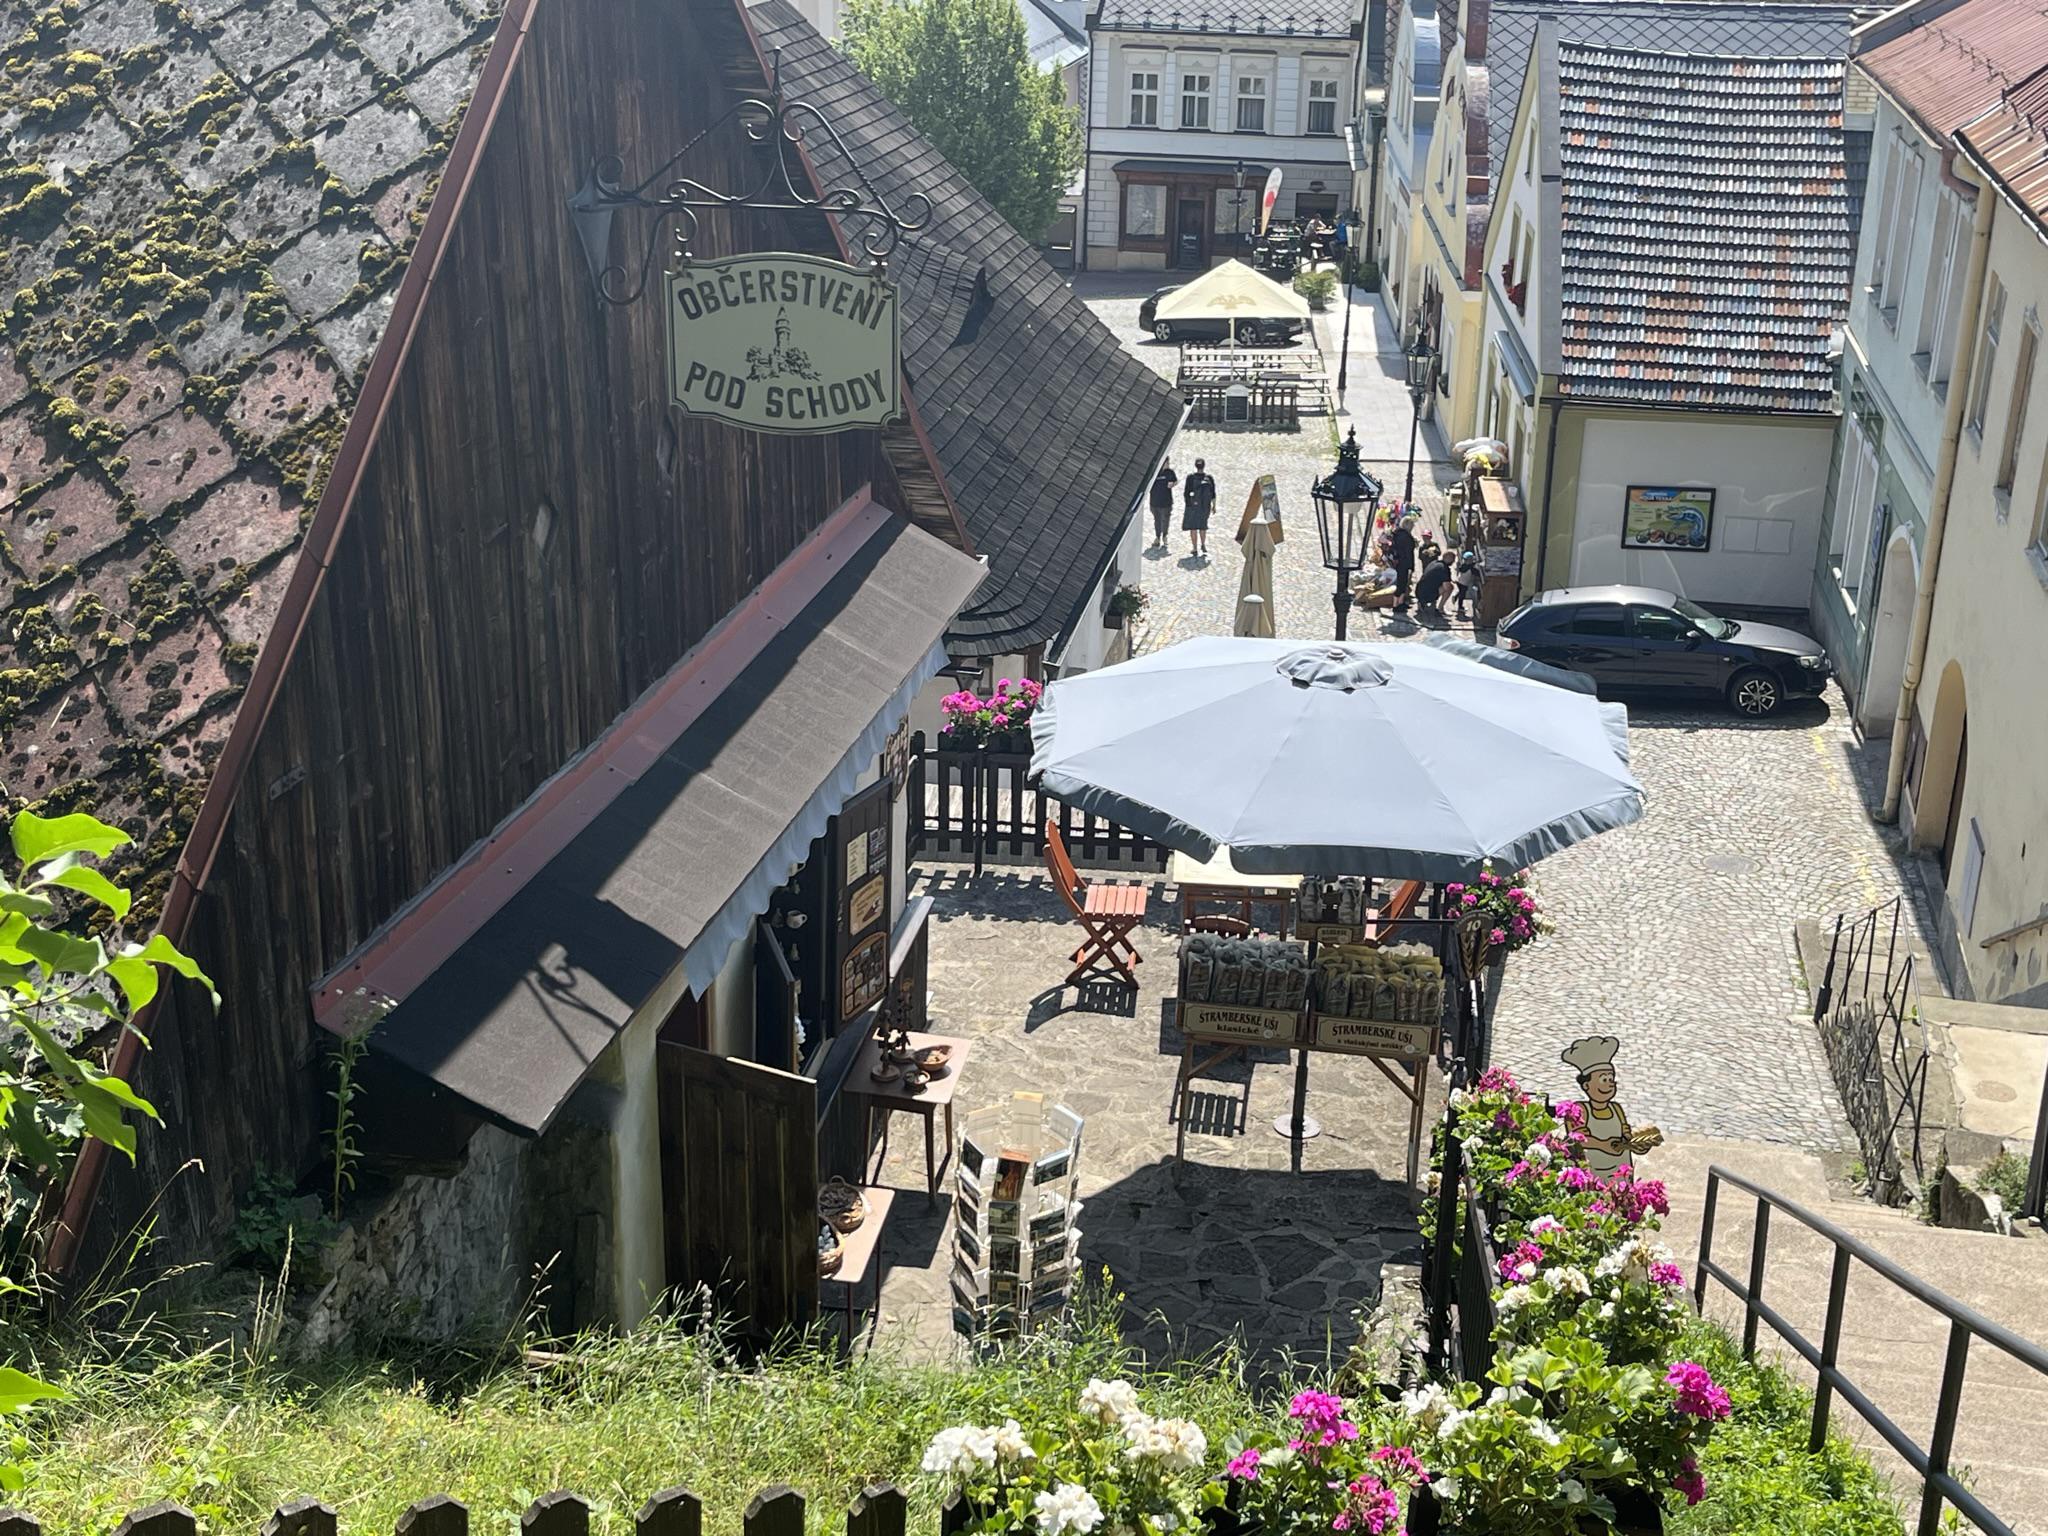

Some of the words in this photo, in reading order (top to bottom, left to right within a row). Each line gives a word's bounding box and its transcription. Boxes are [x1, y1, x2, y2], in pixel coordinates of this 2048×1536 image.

[677, 266, 893, 331] OBČERSTVENÍ
[684, 361, 746, 411] POD
[765, 368, 887, 420] SCHODY
[1466, 919, 1482, 932] 10
